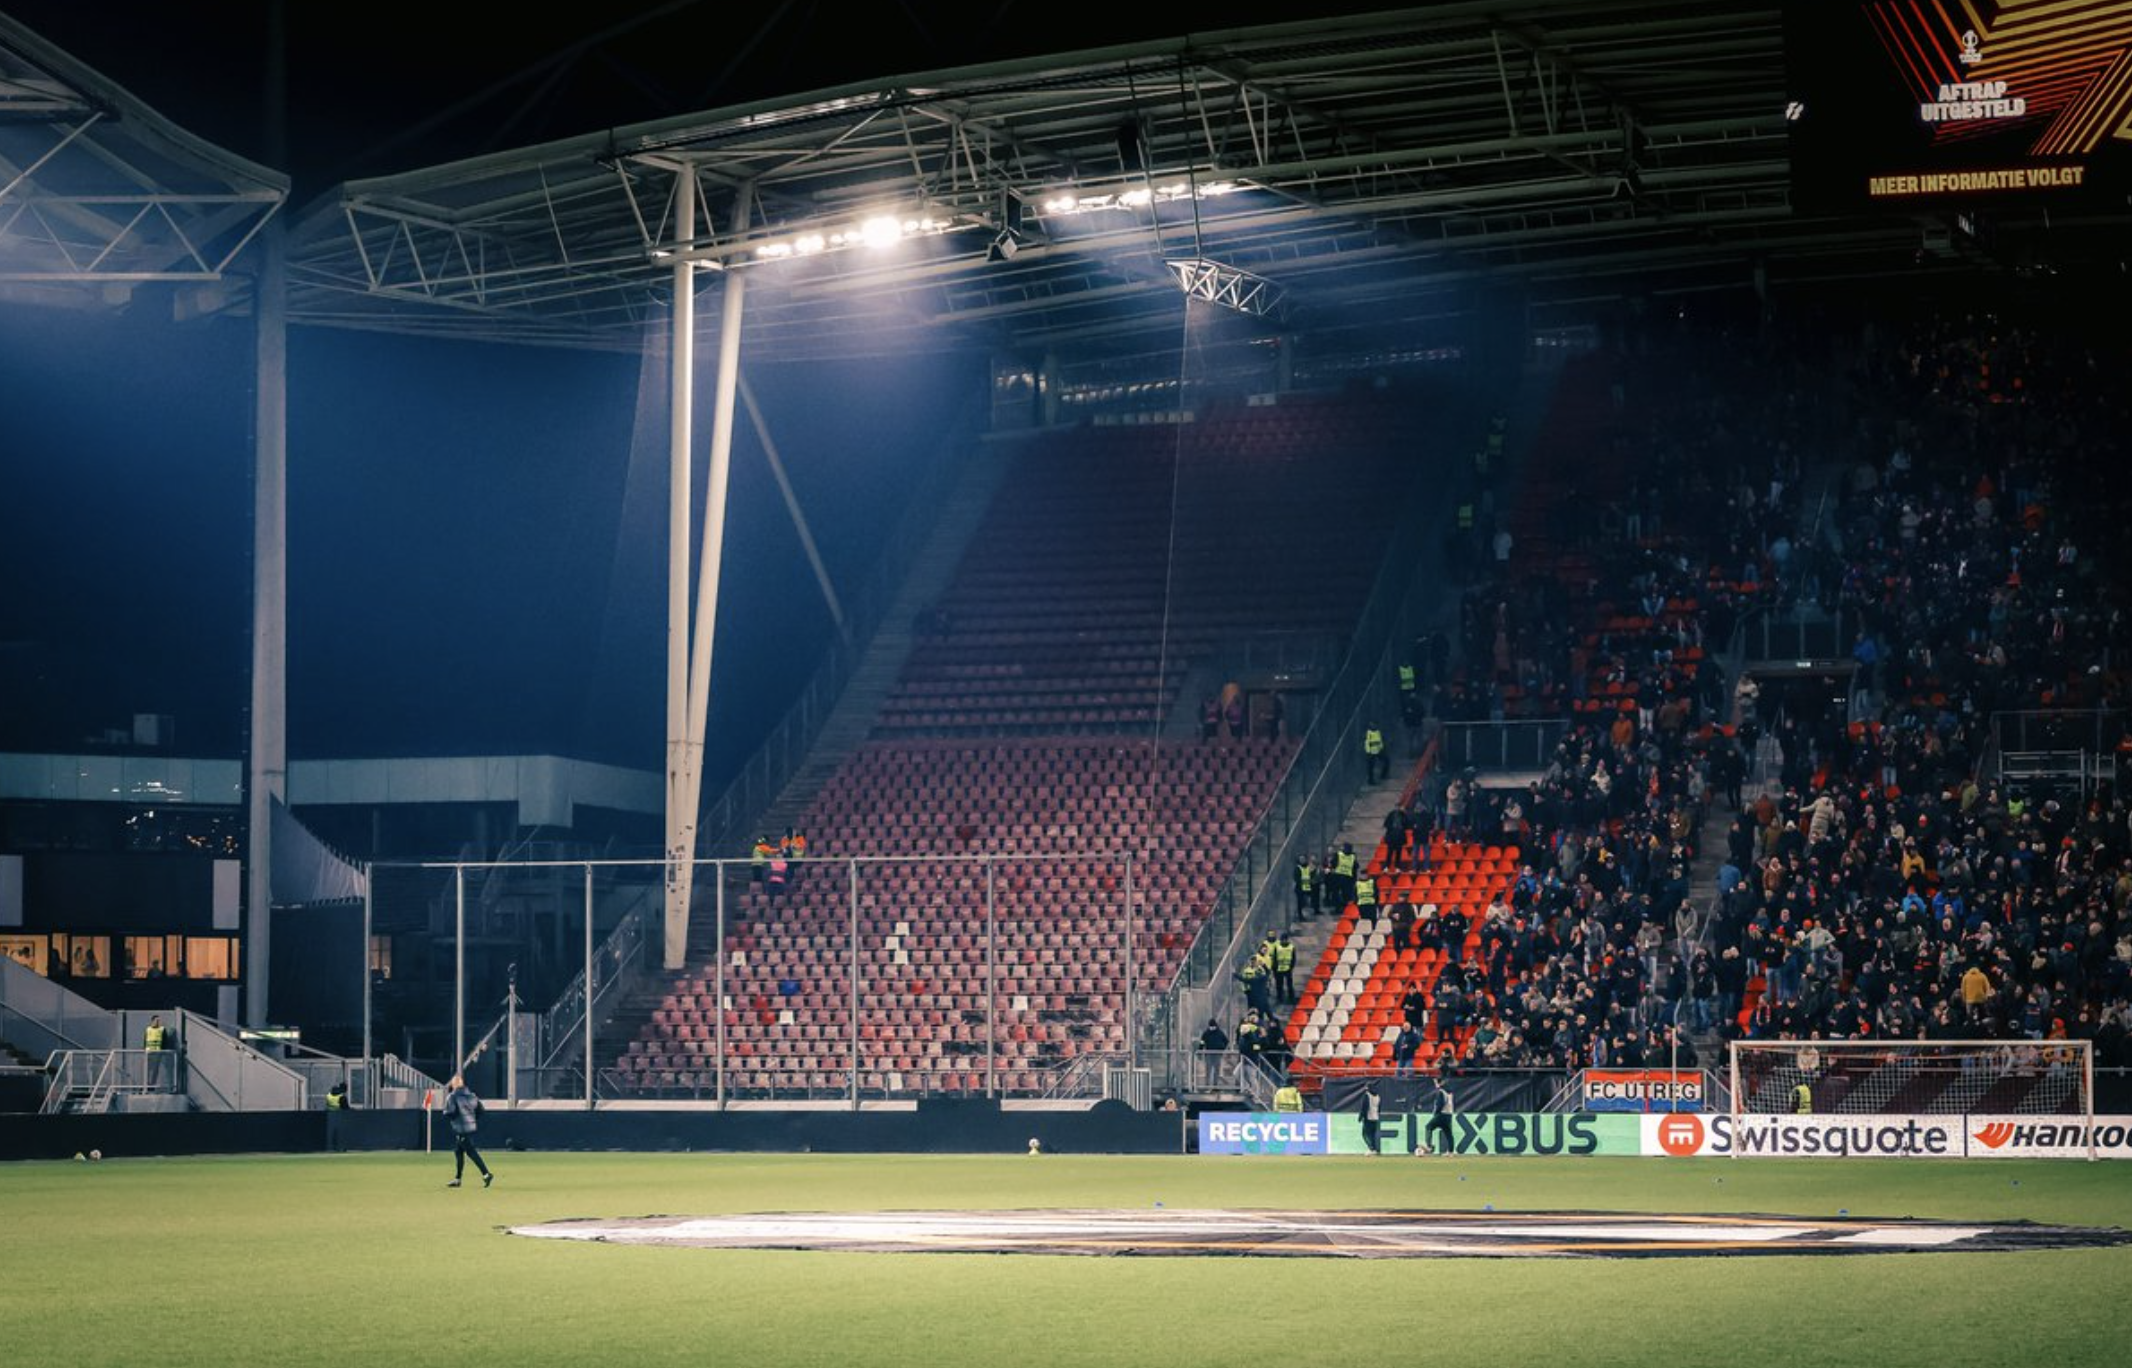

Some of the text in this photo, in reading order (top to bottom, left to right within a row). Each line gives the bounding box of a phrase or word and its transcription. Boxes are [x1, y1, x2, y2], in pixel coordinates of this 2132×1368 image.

[1939, 82, 2007, 101] AFTRAP
[1921, 98, 2026, 121] UITGESTELD
[1870, 166, 2084, 195] MEER INFORMATIE VOLGT
[1590, 1081, 1697, 1100] FC UTREG
[1209, 1122, 1319, 1142] RECYCLE
[1711, 1115, 1947, 1156] Swissquote
